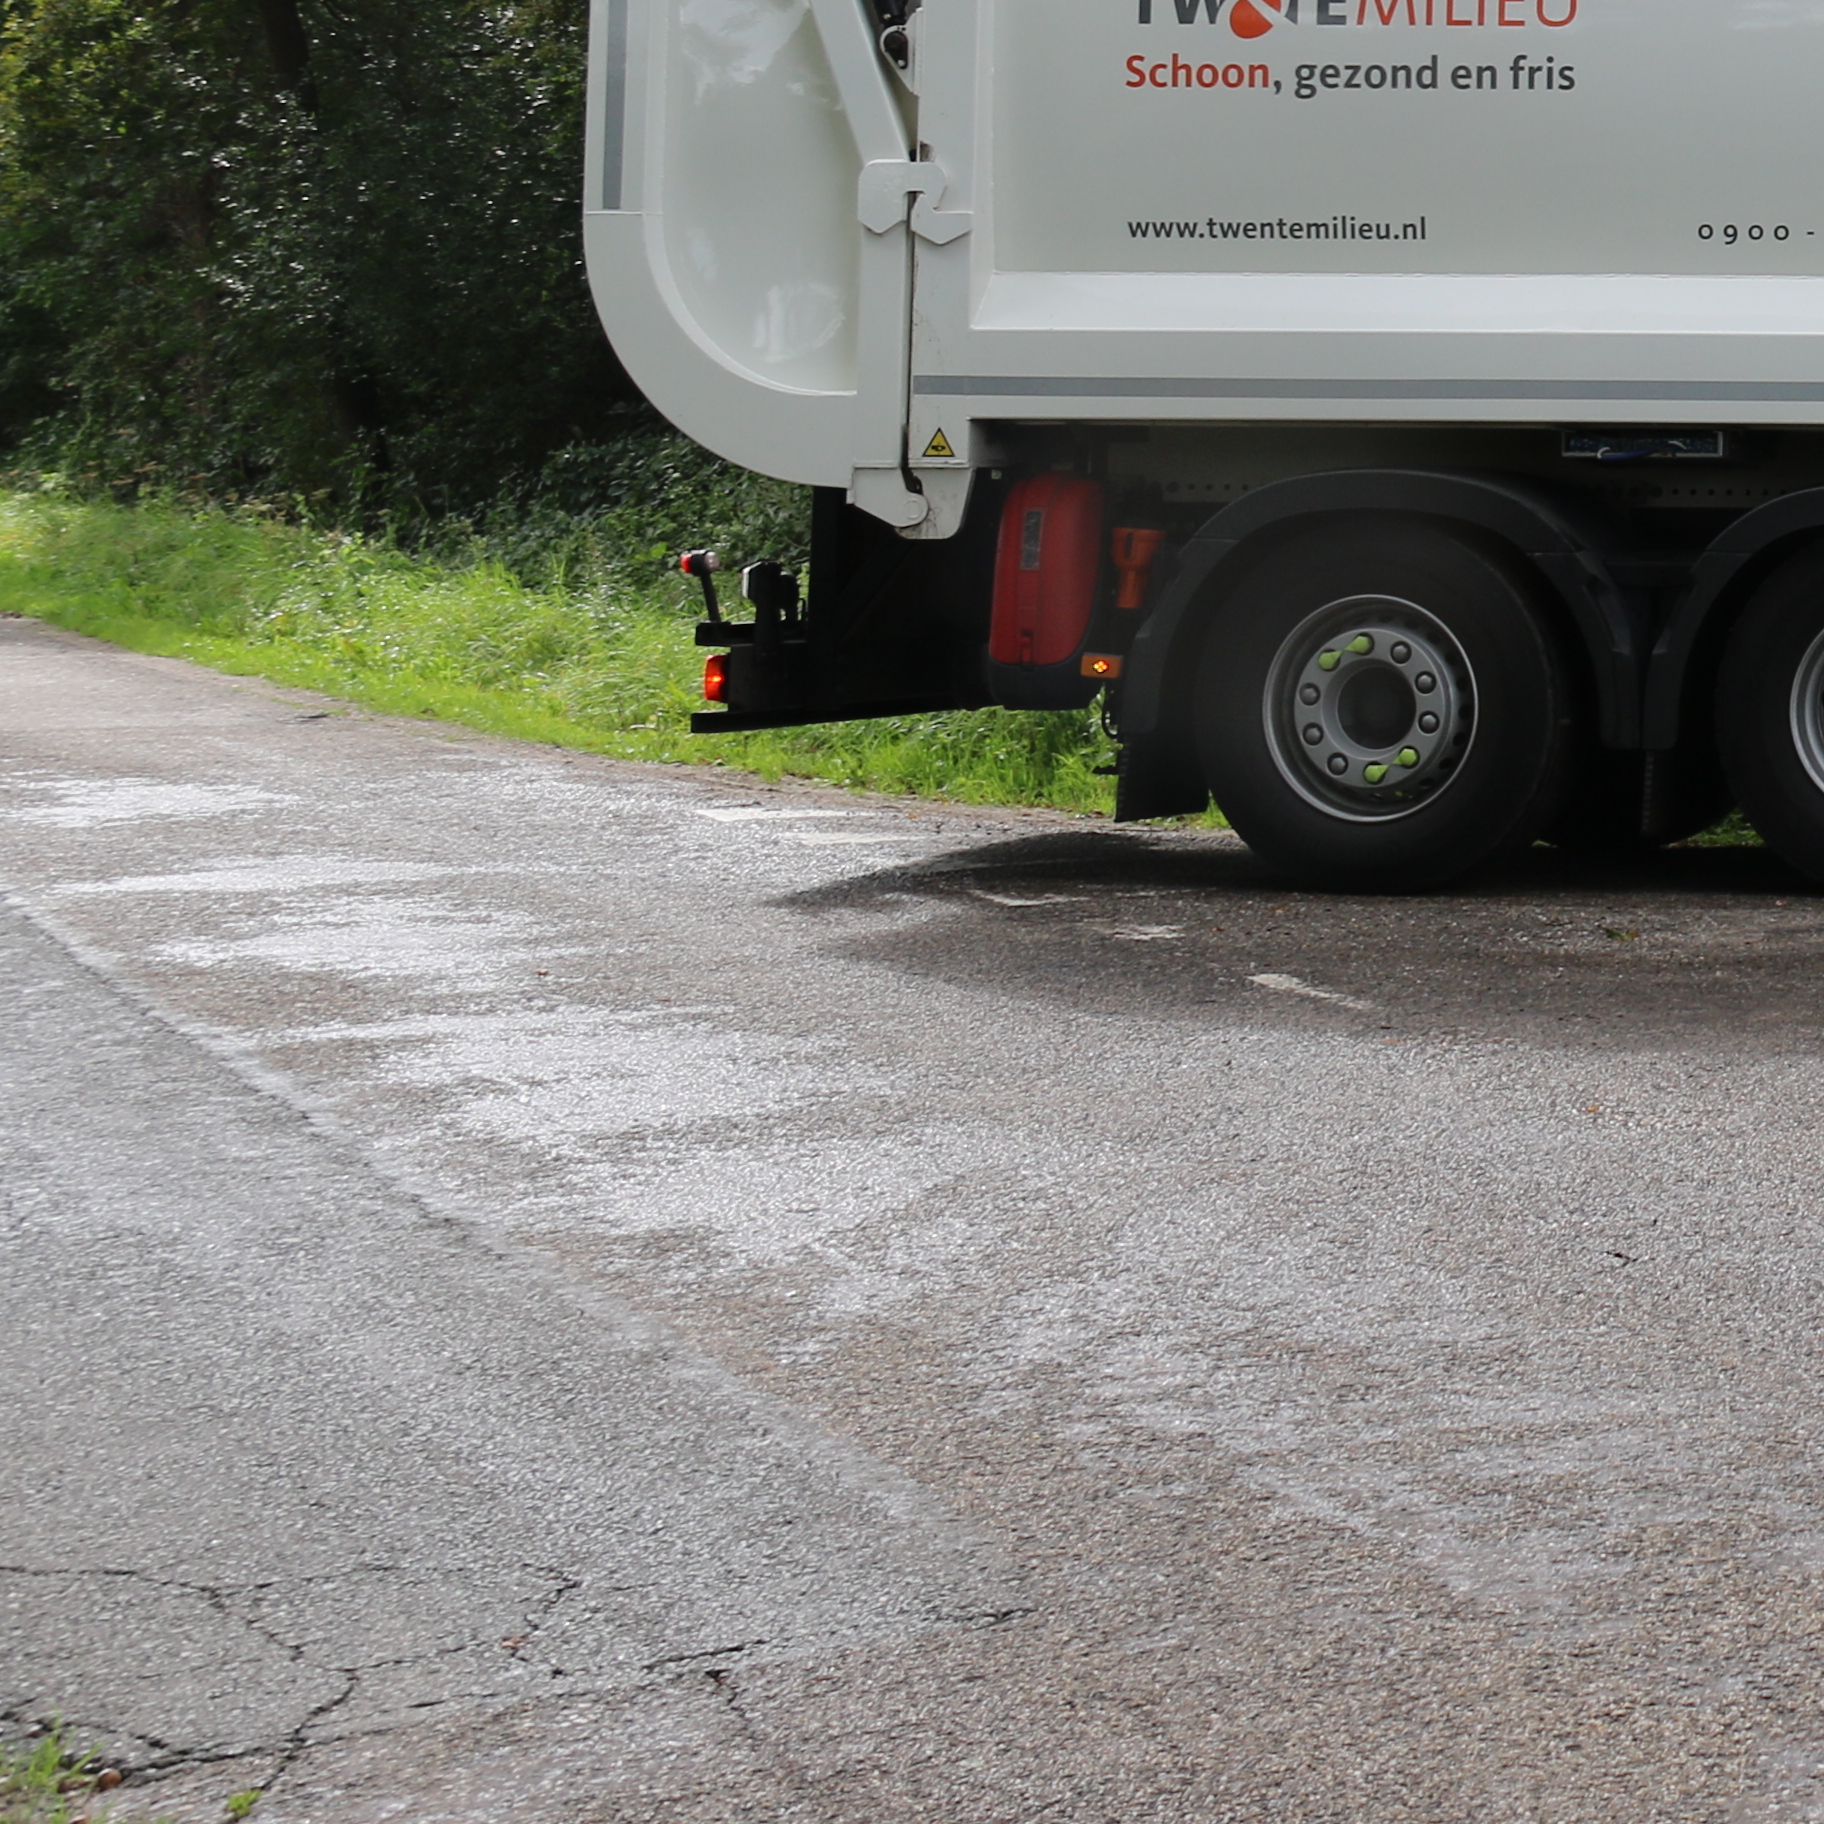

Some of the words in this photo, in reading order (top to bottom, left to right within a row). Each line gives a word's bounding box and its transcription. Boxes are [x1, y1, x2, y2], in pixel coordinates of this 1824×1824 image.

[1125, 53, 1282, 95] Schoon,
[1294, 54, 1438, 100] gezond
[1450, 64, 1498, 90] en
[1509, 54, 1576, 91] fris
[1127, 215, 1426, 240] www.twentemilieu.nl
[1697, 223, 1790, 246] 0900
